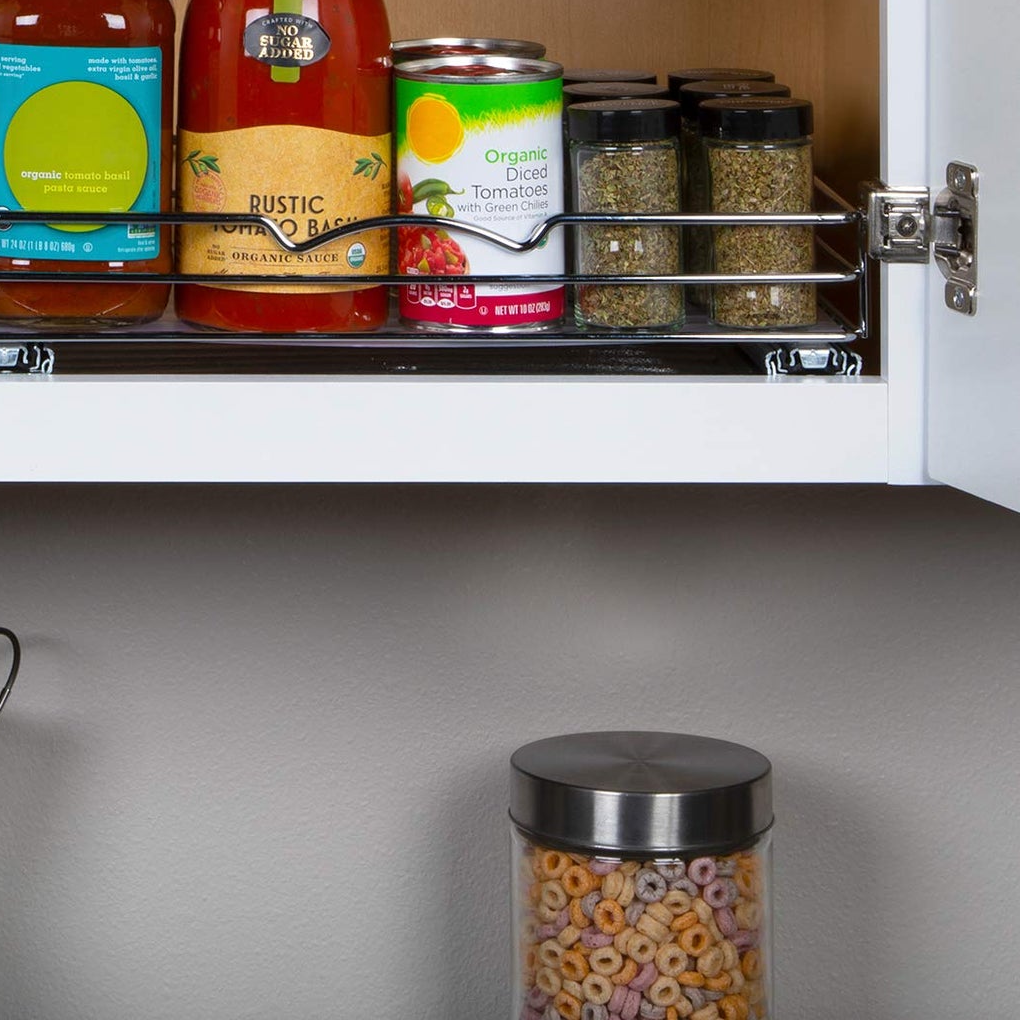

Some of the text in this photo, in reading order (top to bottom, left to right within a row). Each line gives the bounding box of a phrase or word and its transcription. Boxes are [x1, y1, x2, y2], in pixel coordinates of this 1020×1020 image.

[261, 16, 314, 29] CRAFTED WITH
[276, 25, 299, 36] NO
[259, 36, 314, 49] SUGAR
[0, 56, 27, 65] serving
[111, 56, 127, 64] with
[258, 47, 315, 61] ADDED
[2, 64, 41, 72] vegetables
[109, 65, 131, 74] virgin
[114, 72, 133, 81] basil
[141, 73, 158, 81] garlic
[485, 147, 548, 165] Organic
[21, 169, 130, 181] organic tomato basil
[506, 165, 548, 182] Diced
[43, 184, 108, 194] pasta sauce
[471, 183, 548, 200] Tomatoes
[249, 194, 325, 215] RUSTIC
[457, 198, 549, 213] with Green Chilies
[232, 250, 339, 264] ORGANIC SAUCE
[495, 305, 507, 316] NET
[508, 304, 520, 315] WT
[520, 303, 528, 314] 10
[528, 302, 536, 313] OZ
